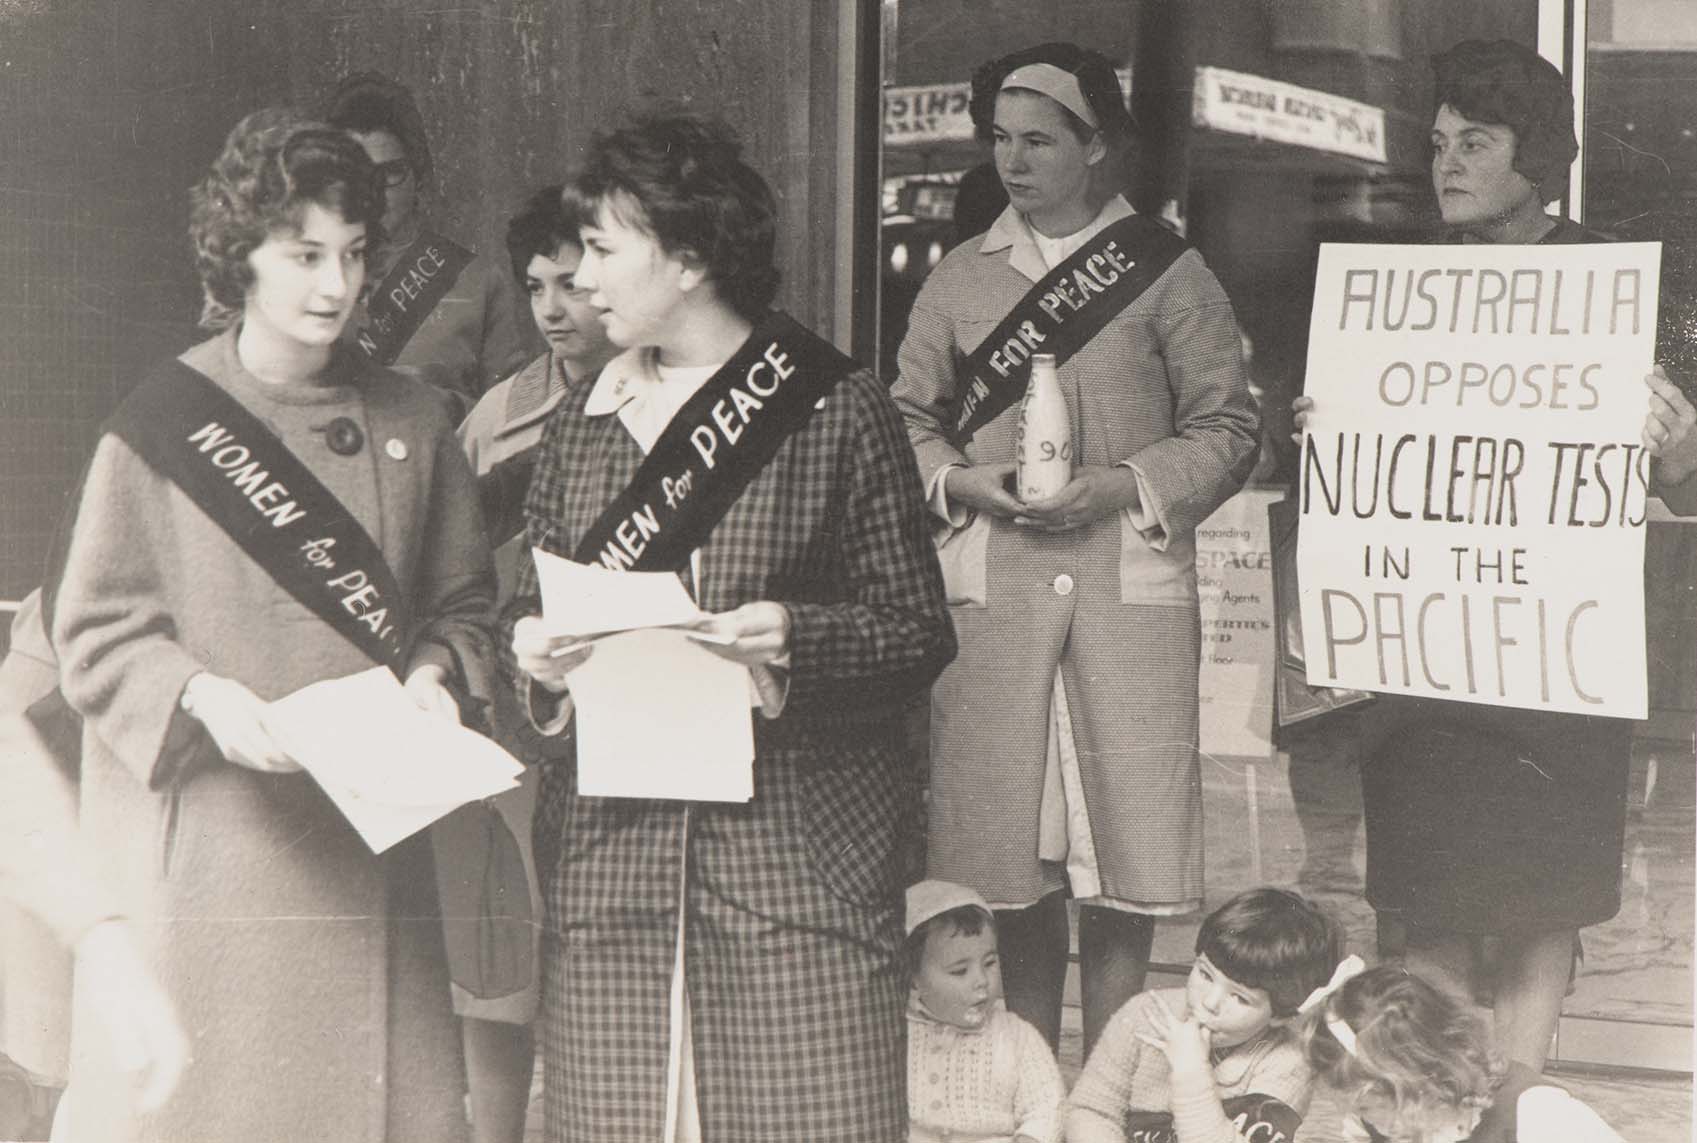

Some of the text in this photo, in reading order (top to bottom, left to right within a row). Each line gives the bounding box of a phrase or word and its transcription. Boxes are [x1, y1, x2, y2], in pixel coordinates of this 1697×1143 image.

[389, 246, 446, 312] PEACE
[989, 320, 1047, 378] FOR
[1038, 241, 1136, 324] PEACE
[1338, 268, 1641, 335] AUSTRALIA
[1378, 361, 1603, 411] OPPOSES
[661, 469, 693, 510] for
[690, 342, 796, 470] PEACE
[188, 421, 307, 527] WOMEN
[300, 537, 336, 569] for
[1303, 432, 1649, 528] NUCLEAR TESTS
[1197, 527, 1251, 541] regarding
[1197, 551, 1272, 570] SPACE
[1364, 545, 1529, 585] IN THE
[1223, 590, 1261, 605] Agents
[1321, 588, 1605, 705] PACIFIC
